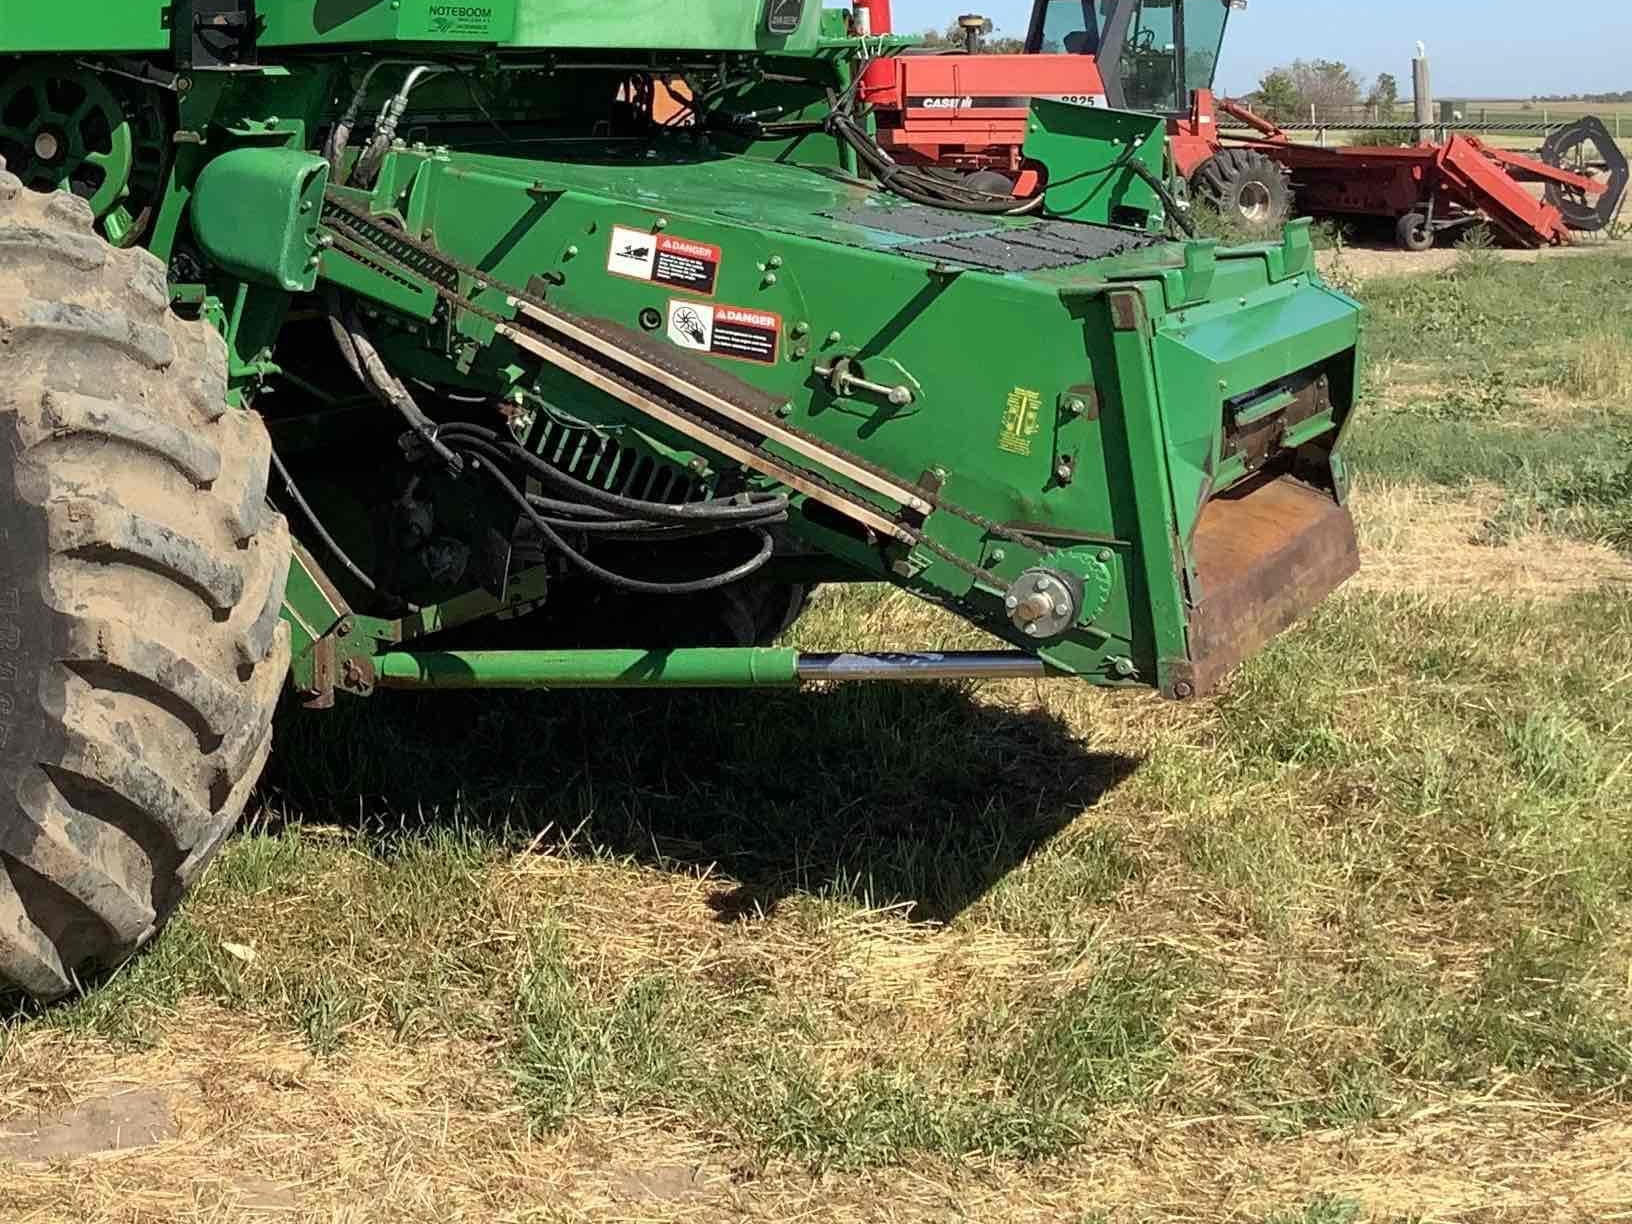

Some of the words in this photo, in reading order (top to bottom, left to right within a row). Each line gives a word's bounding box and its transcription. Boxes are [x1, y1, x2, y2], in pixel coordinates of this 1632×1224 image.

[429, 6, 491, 17] NOTEBOOM
[923, 97, 959, 109] CASE
[672, 241, 712, 257] DANGER
[727, 310, 775, 327] DANGER
